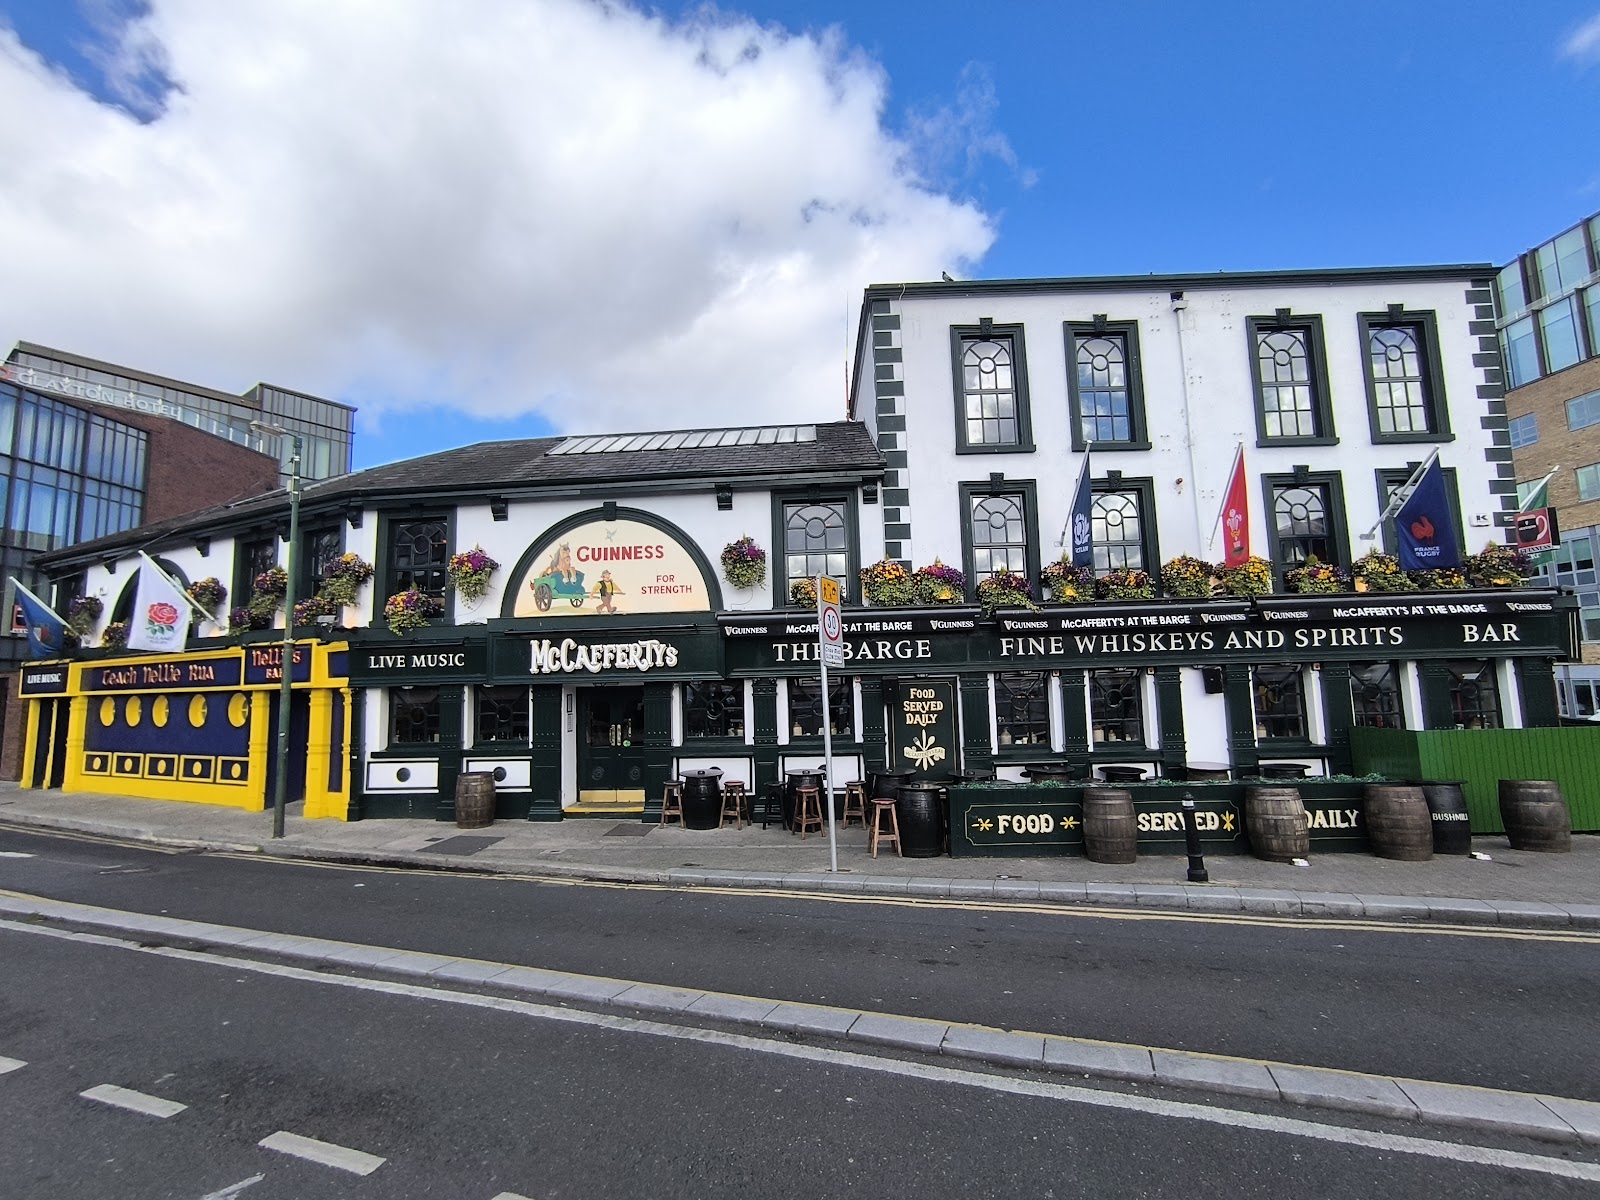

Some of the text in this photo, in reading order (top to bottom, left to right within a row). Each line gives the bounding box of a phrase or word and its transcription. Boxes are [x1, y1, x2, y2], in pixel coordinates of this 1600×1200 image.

[18, 371, 179, 416] CLAYTON HOTEL
[577, 545, 664, 562] GUINNESS
[656, 575, 675, 583] FOR
[641, 585, 692, 595] STRENGTH
[1333, 604, 1488, 618] McCAFFERTY'S AT THE BARGE
[1514, 602, 1552, 611] GUINNESS
[827, 614, 836, 629] 30
[1208, 613, 1246, 623] GUINNESS
[1271, 611, 1309, 620] GUINNESS
[850, 622, 863, 631] AT
[864, 622, 881, 631] THE
[882, 621, 913, 631] BARGE
[937, 620, 975, 629] GUINNESS
[1011, 620, 1048, 630] GUINNESS
[1061, 615, 1191, 629] McCAFFERTY'S AT THE BARGE
[732, 626, 768, 635] GUINNESS
[1463, 623, 1520, 643] BAR
[1000, 627, 1404, 656] FINE WHISKEYS AND SPIRITS
[369, 653, 465, 669] LIVE MUSIC
[27, 673, 62, 684] LIVE MUSIC
[909, 688, 935, 699] FOOD
[903, 700, 944, 713] SERVED
[905, 713, 938, 727] DAILY
[997, 814, 1055, 834] FOOD
